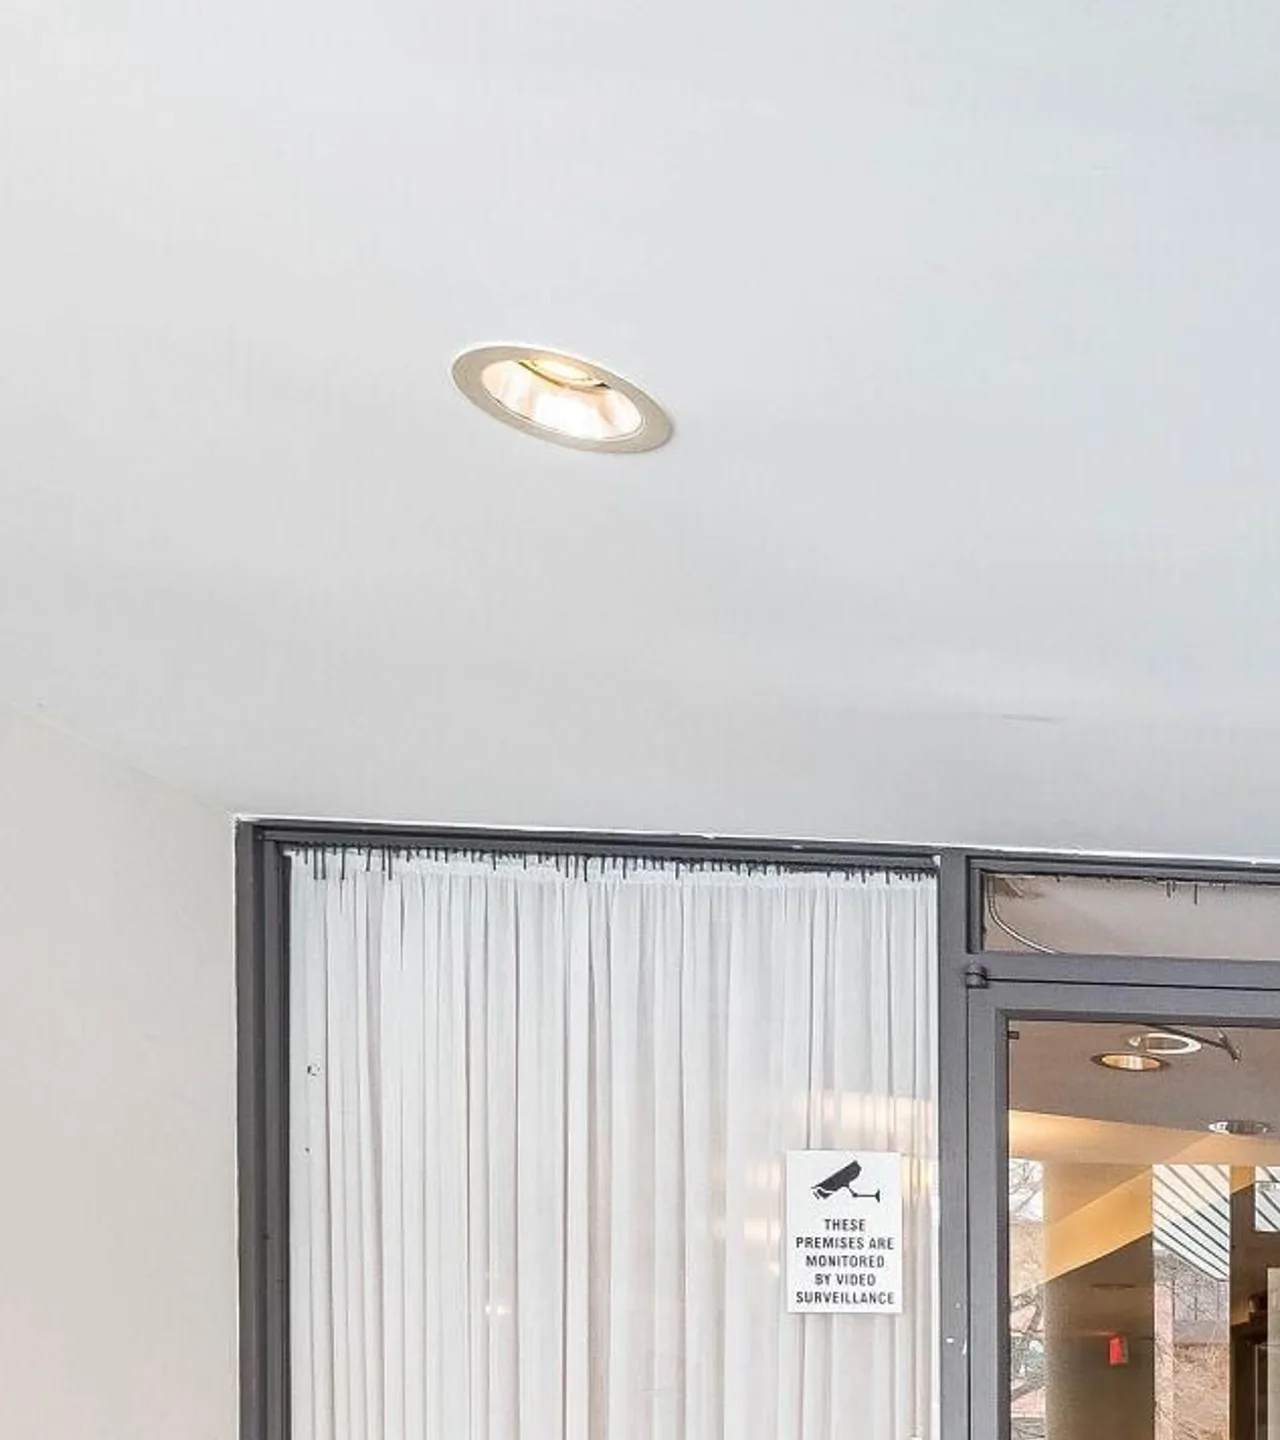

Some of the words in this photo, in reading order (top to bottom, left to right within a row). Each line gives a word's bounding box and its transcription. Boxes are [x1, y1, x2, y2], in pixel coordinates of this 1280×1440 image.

[824, 1218, 866, 1231] THESE
[795, 1237, 865, 1250] PREMISES
[868, 1237, 895, 1250] ARE
[805, 1255, 885, 1268] MONITORED
[814, 1273, 831, 1286] BY
[836, 1273, 877, 1286] VIDEO
[795, 1291, 895, 1305] SURVEILLANCE
